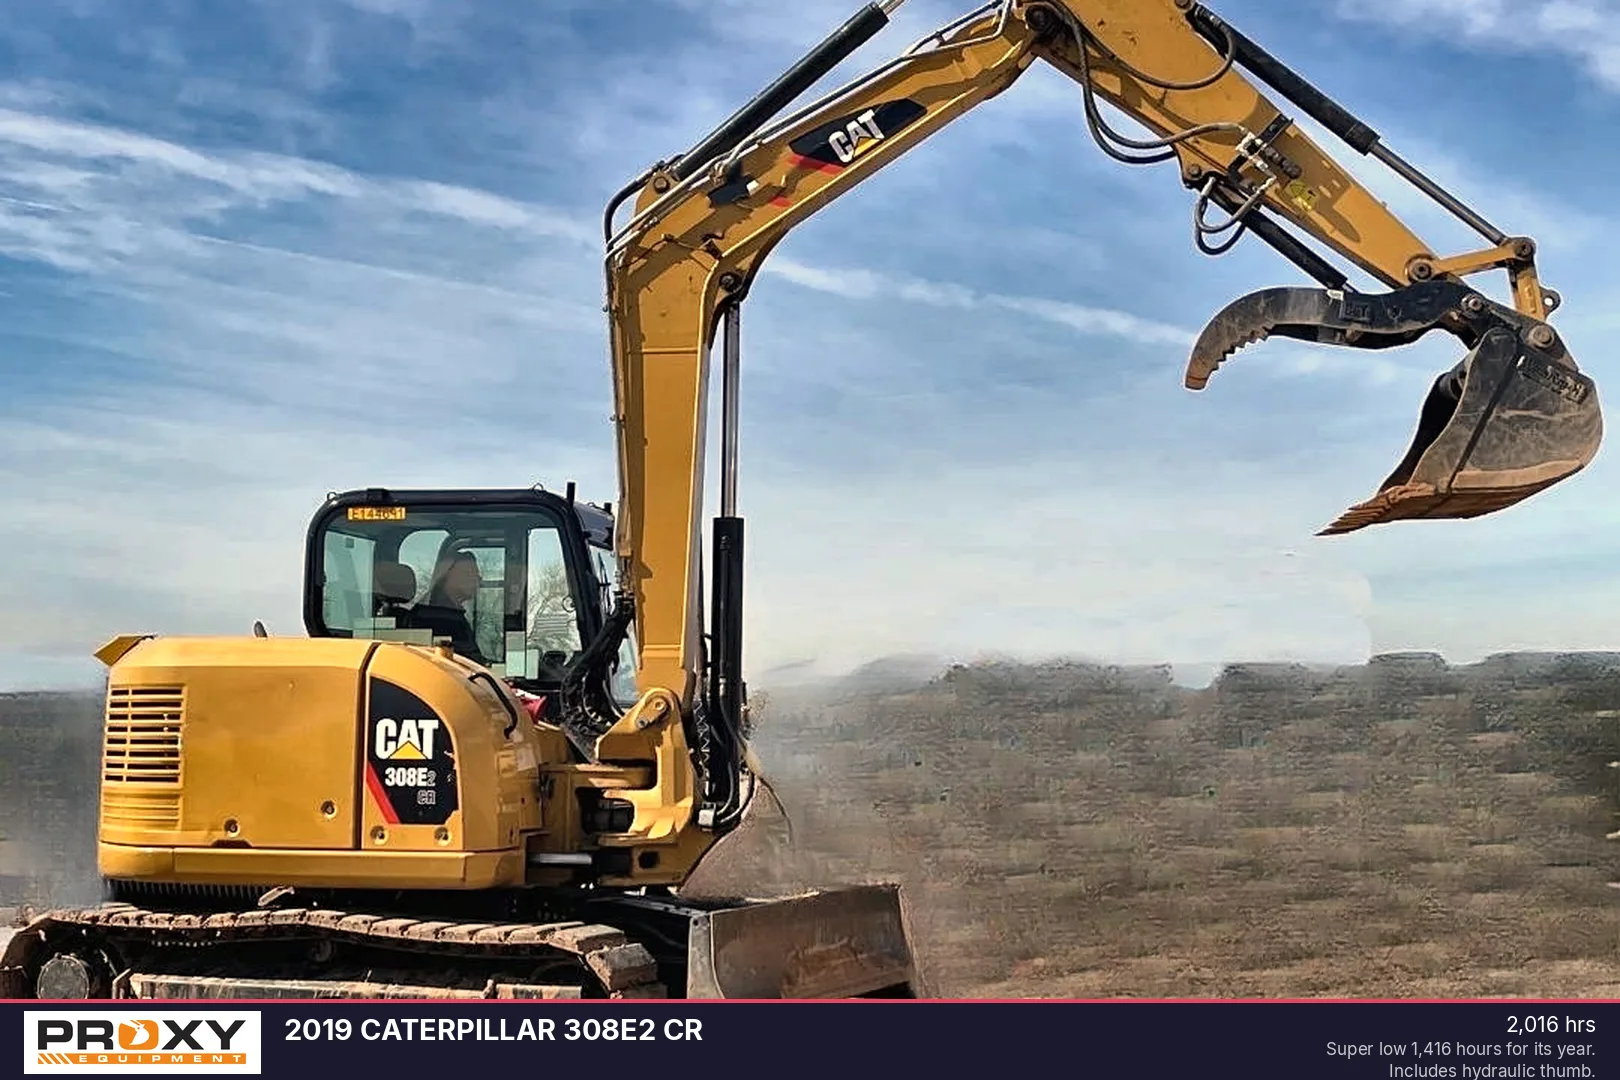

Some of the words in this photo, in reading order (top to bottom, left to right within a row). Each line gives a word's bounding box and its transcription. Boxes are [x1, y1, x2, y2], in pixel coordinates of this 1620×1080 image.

[828, 109, 885, 163] CAT
[375, 718, 439, 759] CAT
[385, 767, 436, 787] 308E2
[417, 790, 436, 805] CR
